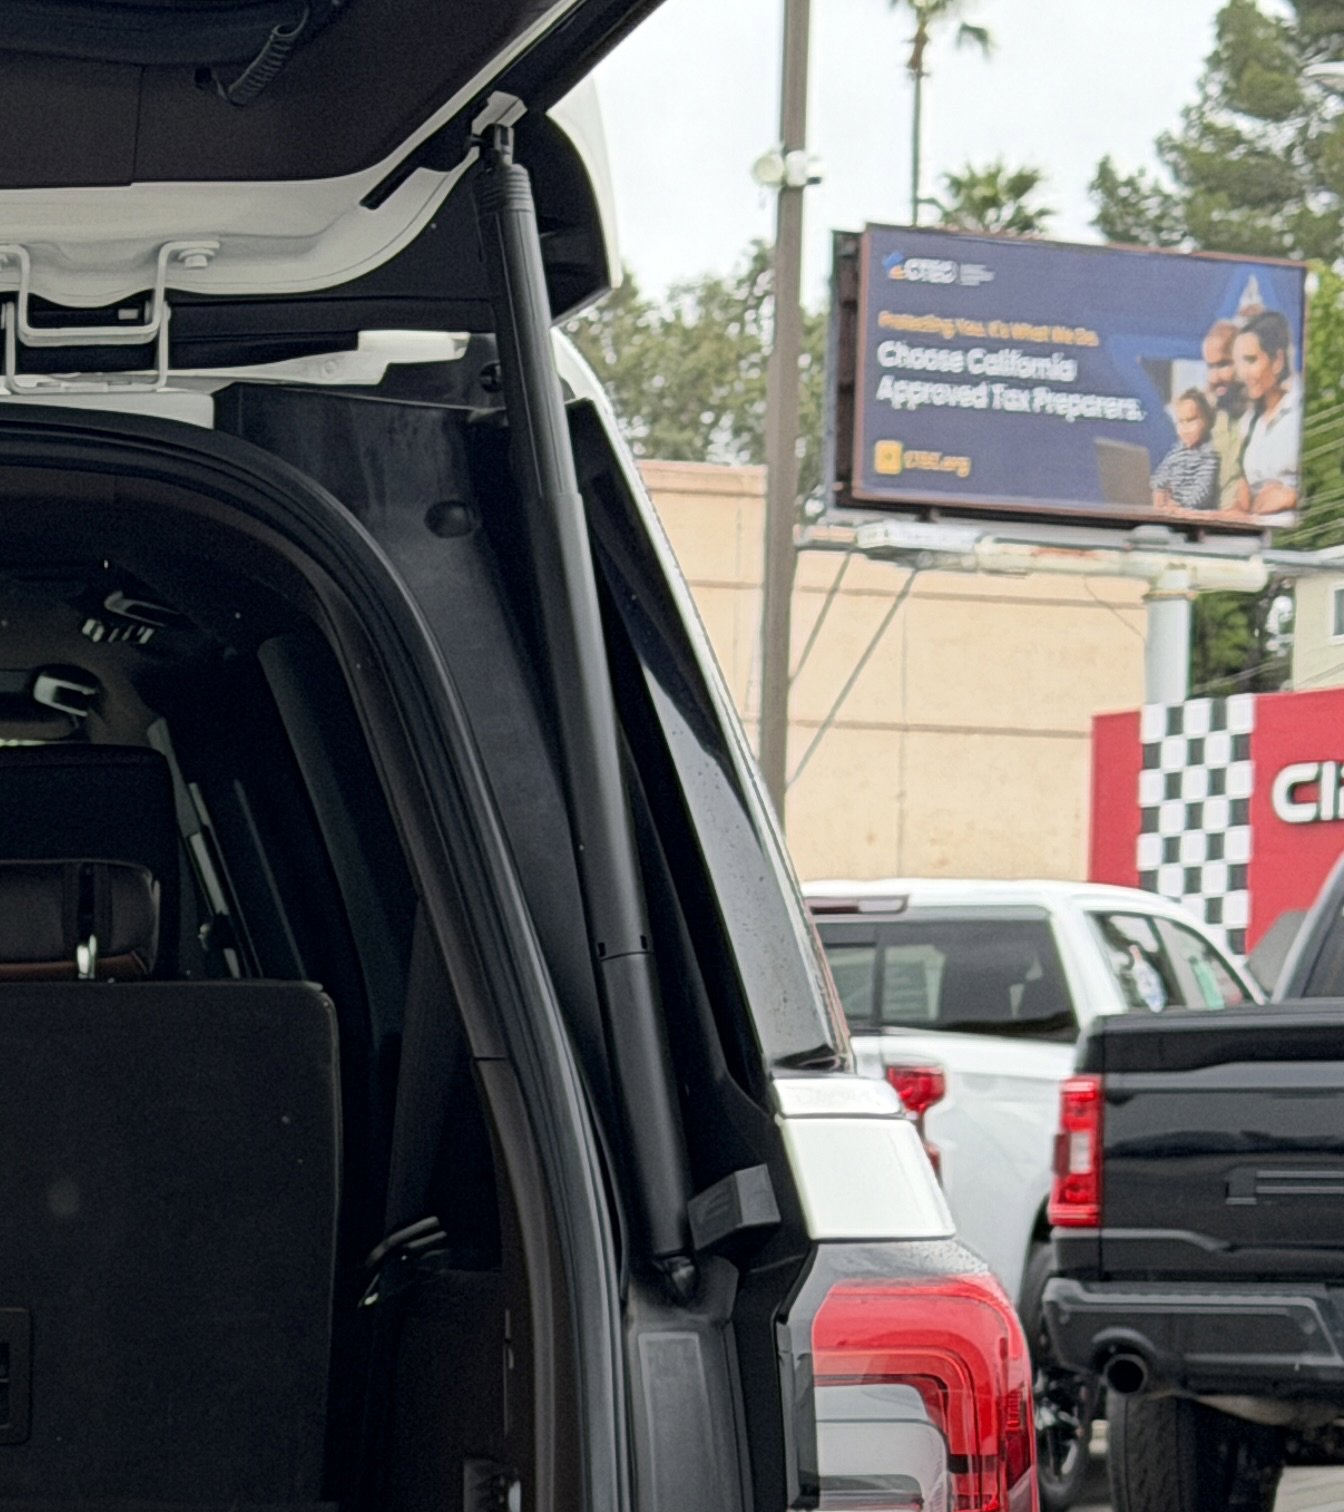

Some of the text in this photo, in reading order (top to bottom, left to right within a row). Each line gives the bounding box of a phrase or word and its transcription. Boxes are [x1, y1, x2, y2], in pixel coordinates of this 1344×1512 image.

[877, 340, 1078, 382] Choose California
[876, 375, 990, 411] Approved
[991, 383, 1031, 413] Tax
